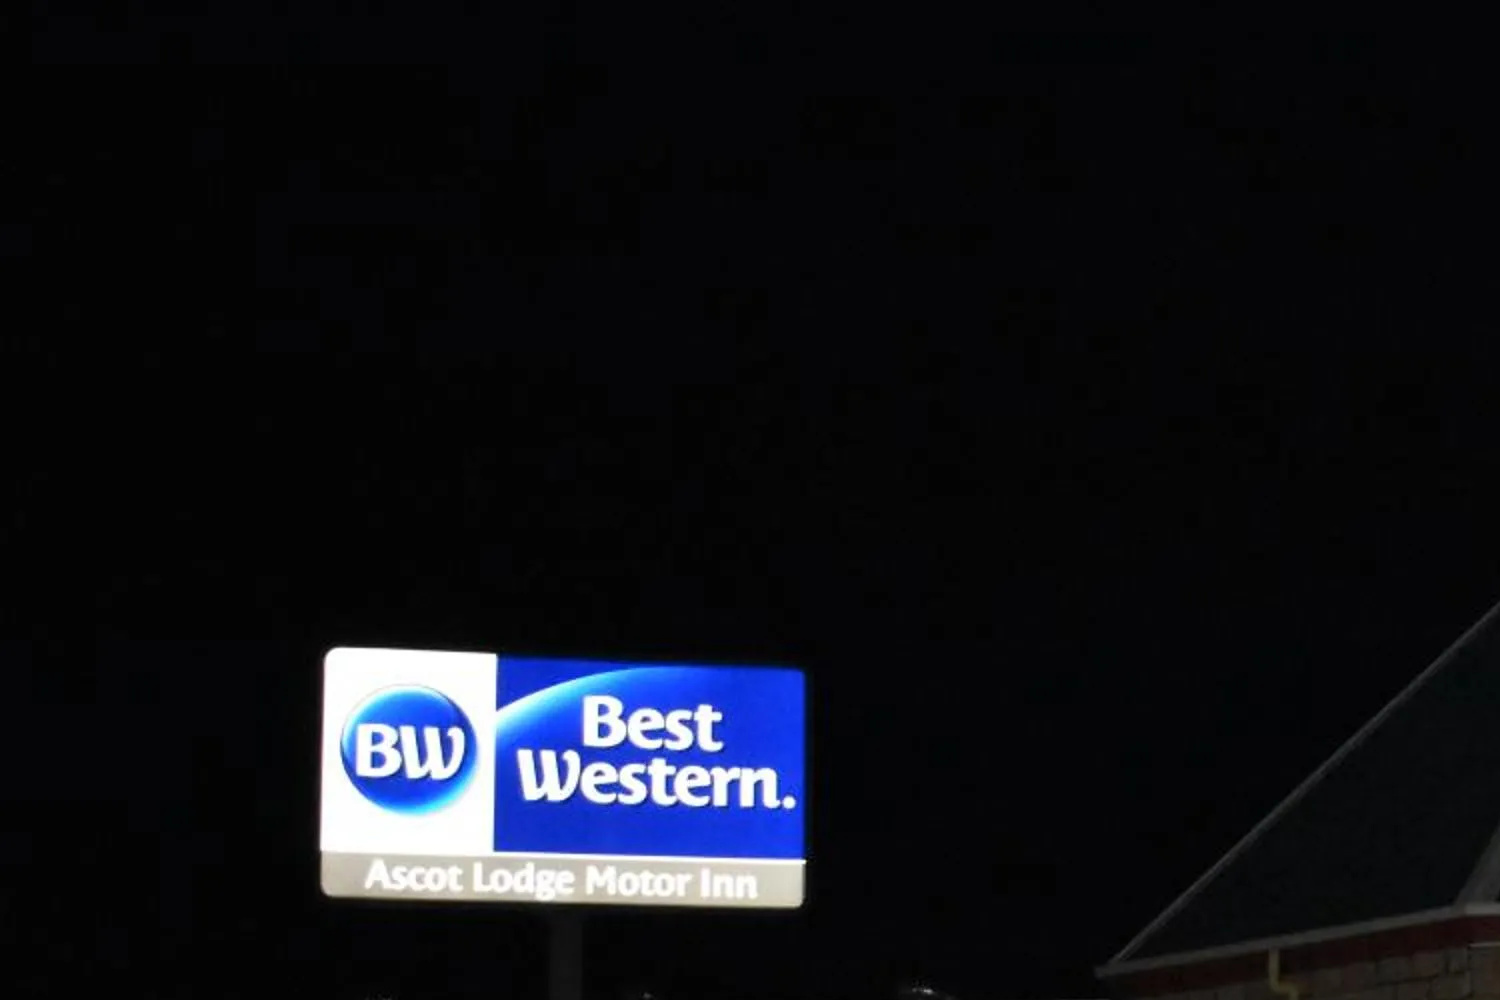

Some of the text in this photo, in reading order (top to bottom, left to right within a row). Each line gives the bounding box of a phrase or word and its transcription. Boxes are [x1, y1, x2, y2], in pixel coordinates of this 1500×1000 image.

[356, 723, 466, 780] BW
[583, 695, 724, 752] Best
[517, 749, 797, 809] Western.
[365, 859, 757, 900] Ascot Lodge Motor Inn
